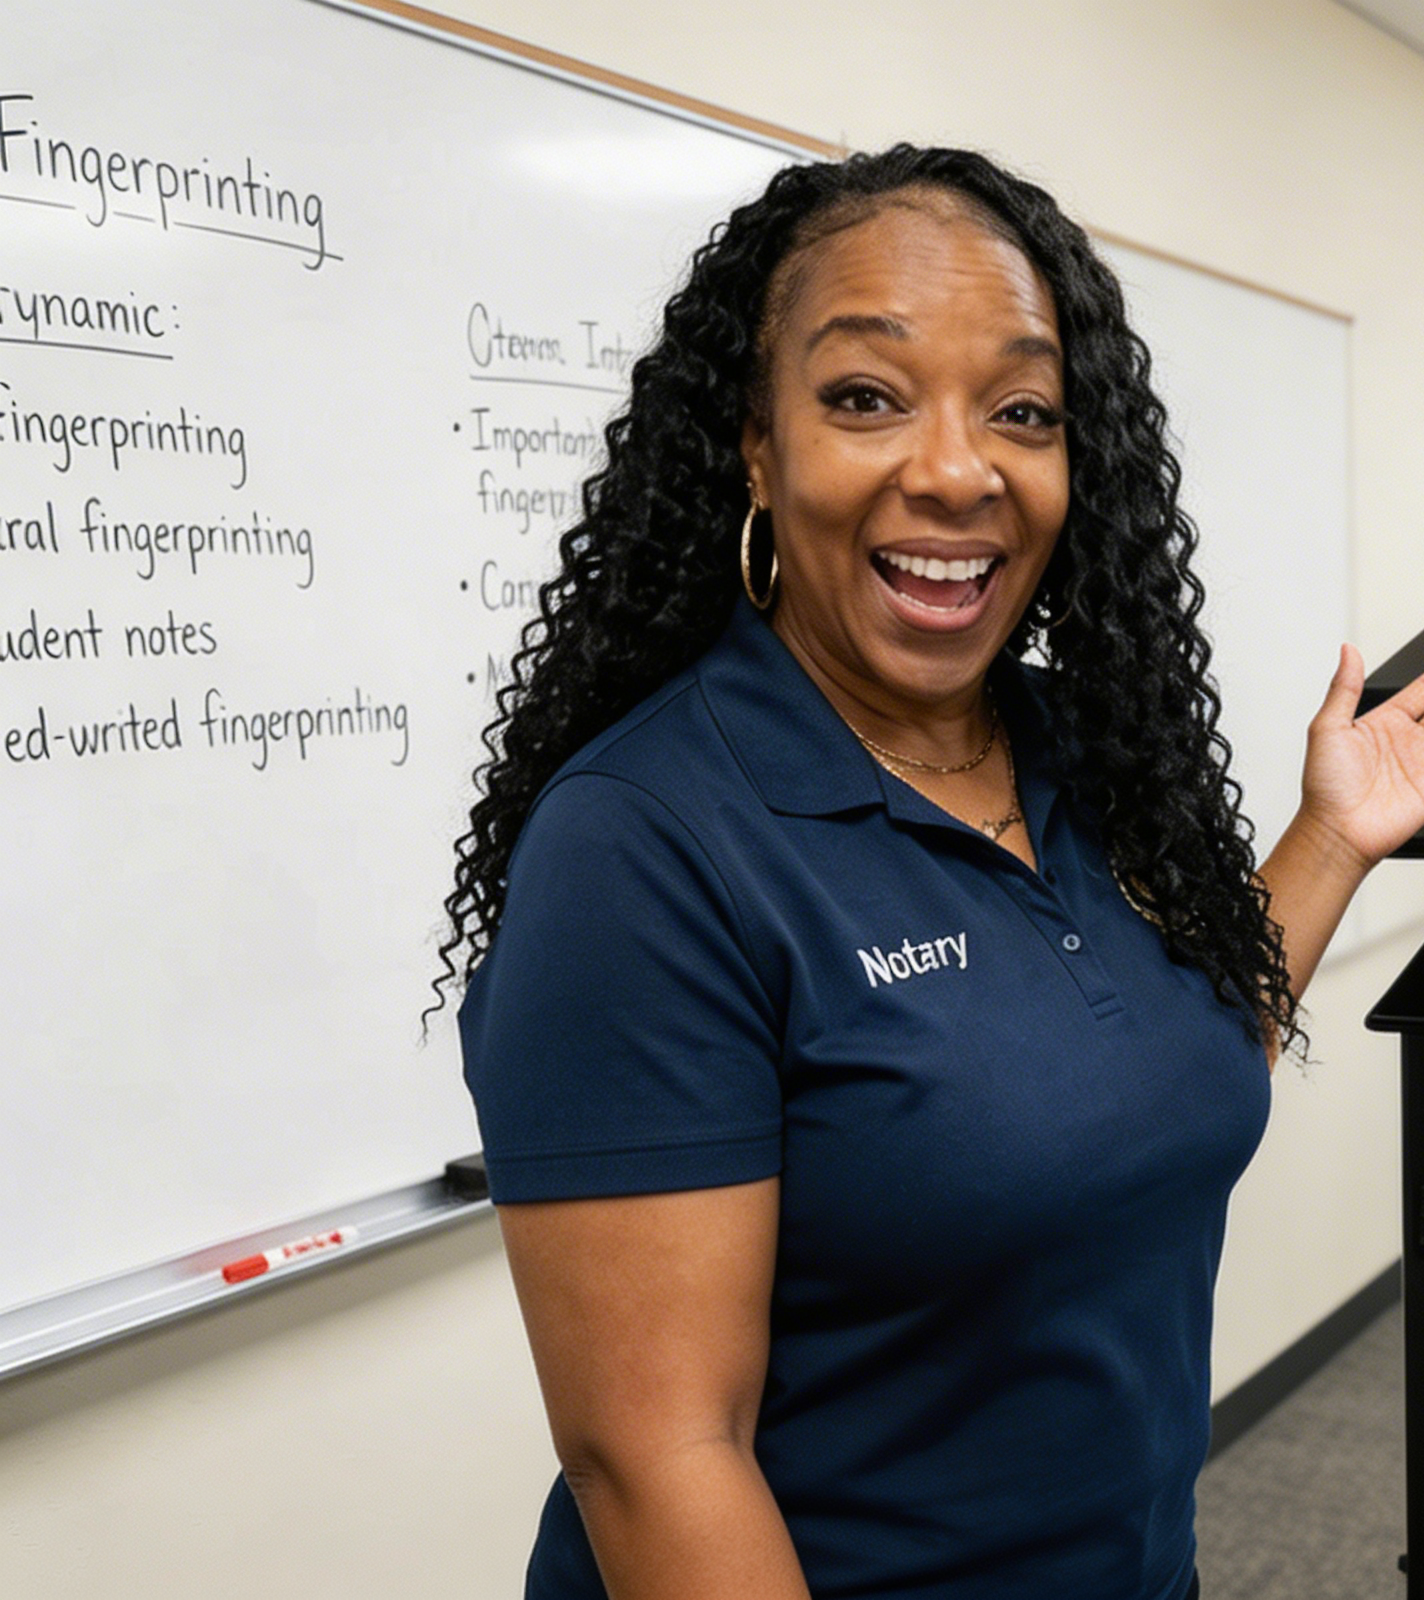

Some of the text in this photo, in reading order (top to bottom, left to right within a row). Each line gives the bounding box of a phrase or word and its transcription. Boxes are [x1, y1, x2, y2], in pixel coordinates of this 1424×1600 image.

[0, 94, 325, 271] Fingerprinting
[80, 497, 315, 589] fingerprinting
[125, 609, 218, 658] notes
[4, 687, 410, 771] ed-writed fingerprinting
[856, 931, 968, 988] Notary
